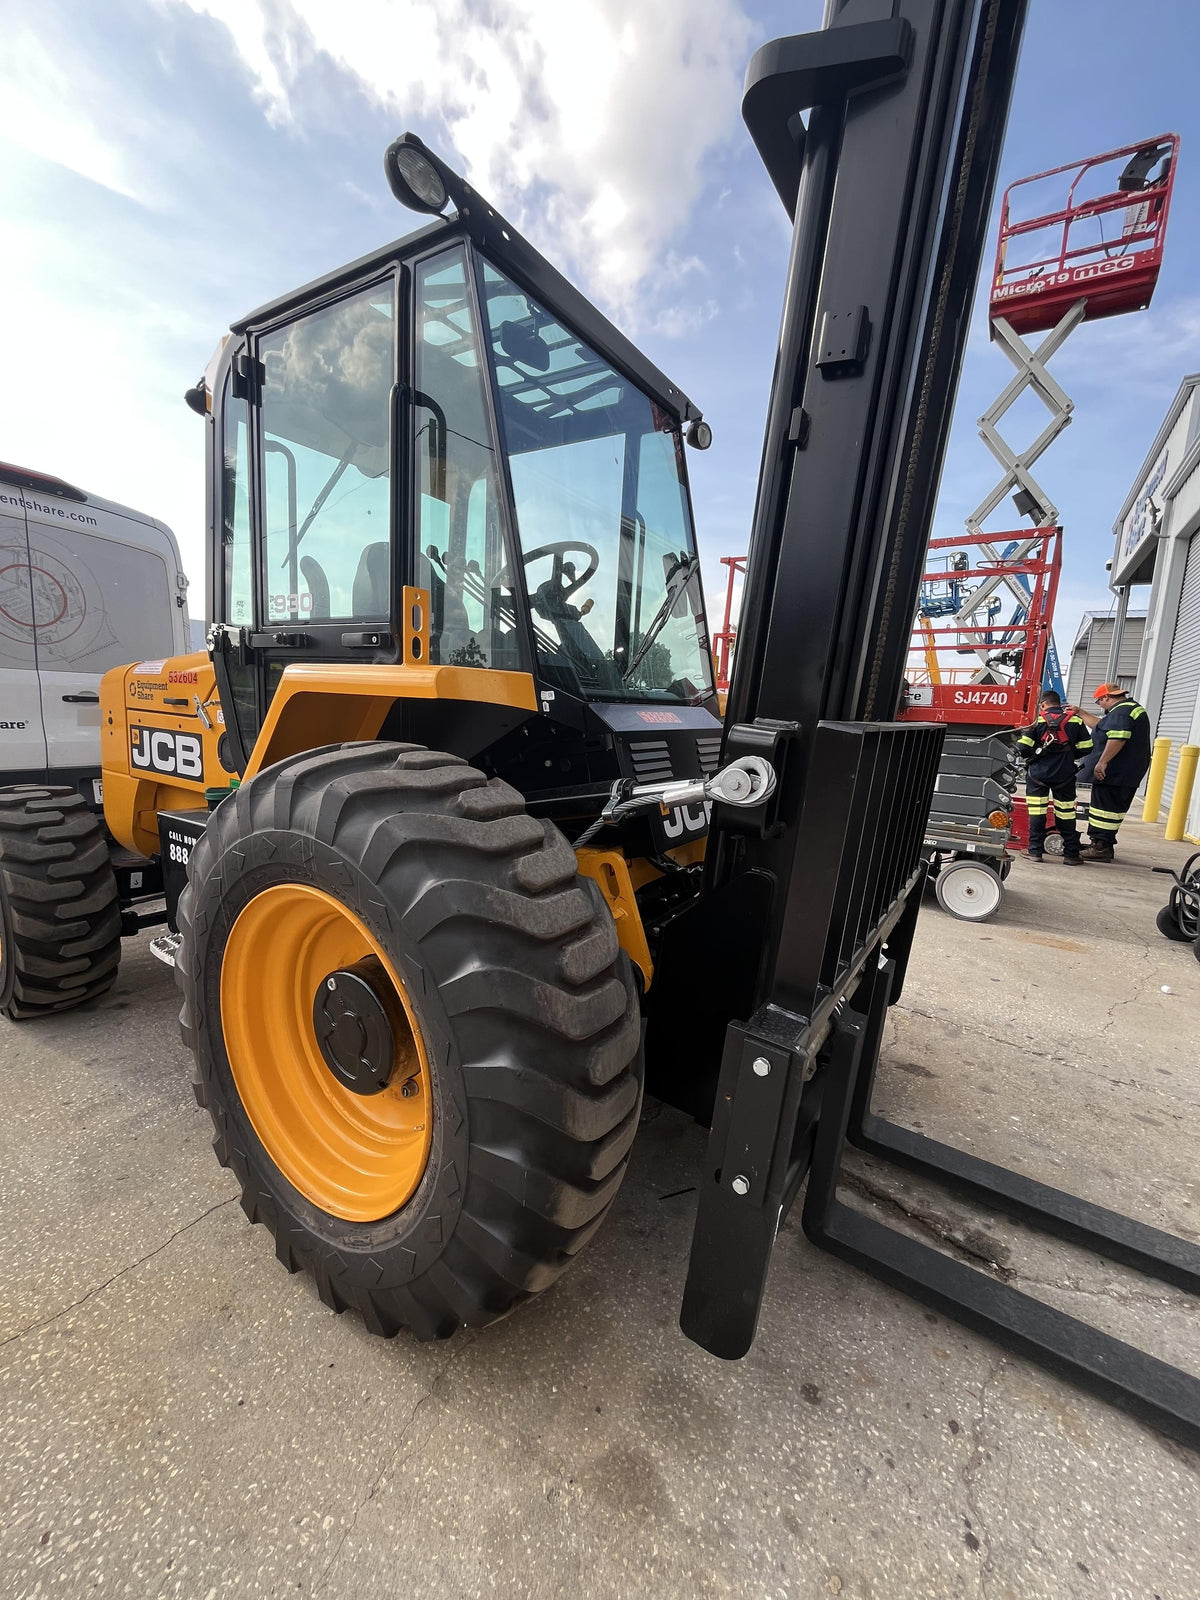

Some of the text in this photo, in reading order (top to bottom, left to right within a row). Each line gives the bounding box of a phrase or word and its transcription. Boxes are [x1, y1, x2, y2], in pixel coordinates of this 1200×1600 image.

[1074, 257, 1134, 281] mec
[273, 592, 313, 614] 930
[168, 671, 198, 684] 532604
[136, 680, 168, 692] Equipment
[137, 690, 154, 701] Share
[954, 691, 1008, 705] SJ4740
[132, 730, 202, 777] JCB
[168, 830, 183, 842] CALL
[169, 843, 189, 865] 888
